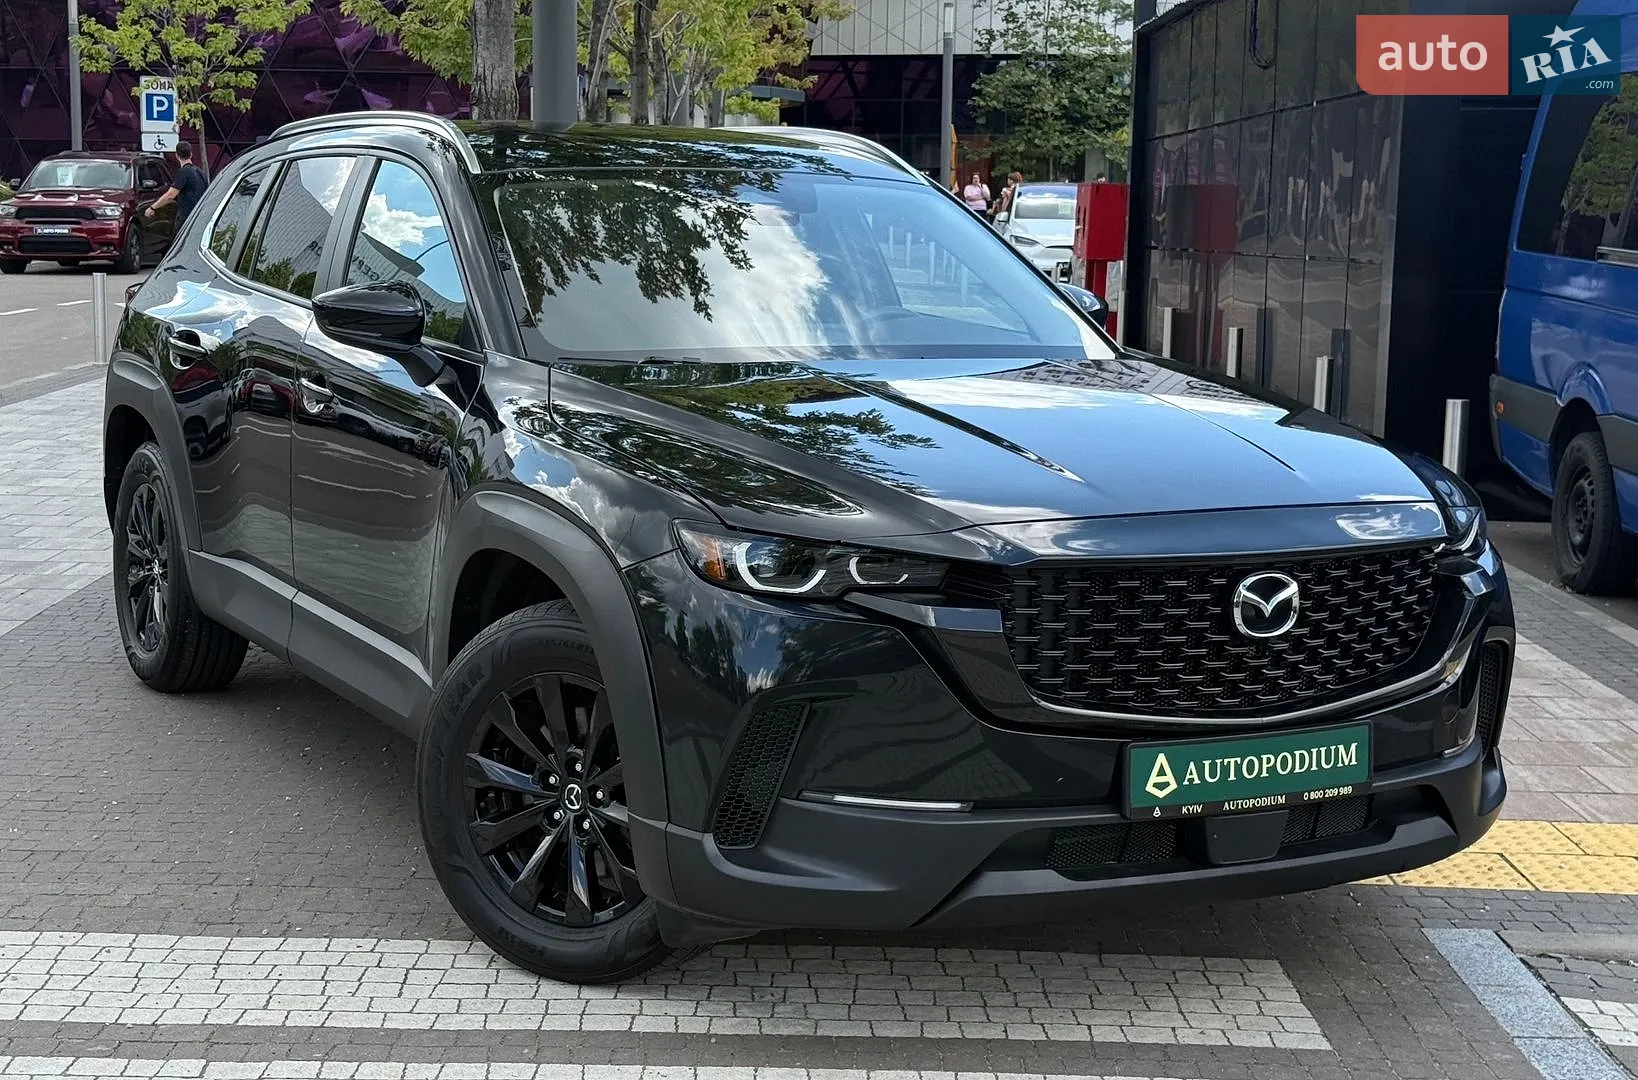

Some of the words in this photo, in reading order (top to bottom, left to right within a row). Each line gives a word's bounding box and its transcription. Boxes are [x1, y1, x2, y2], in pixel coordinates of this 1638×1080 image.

[152, 95, 169, 119] P
[1182, 742, 1358, 786] AUTOPODIUM
[1181, 804, 1203, 815] KYIV
[1222, 794, 1286, 811] AUTOPODIUM
[1303, 791, 1309, 801] 0
[1309, 789, 1324, 800] 800
[1324, 787, 1339, 798] 209
[1339, 785, 1353, 796] 989
